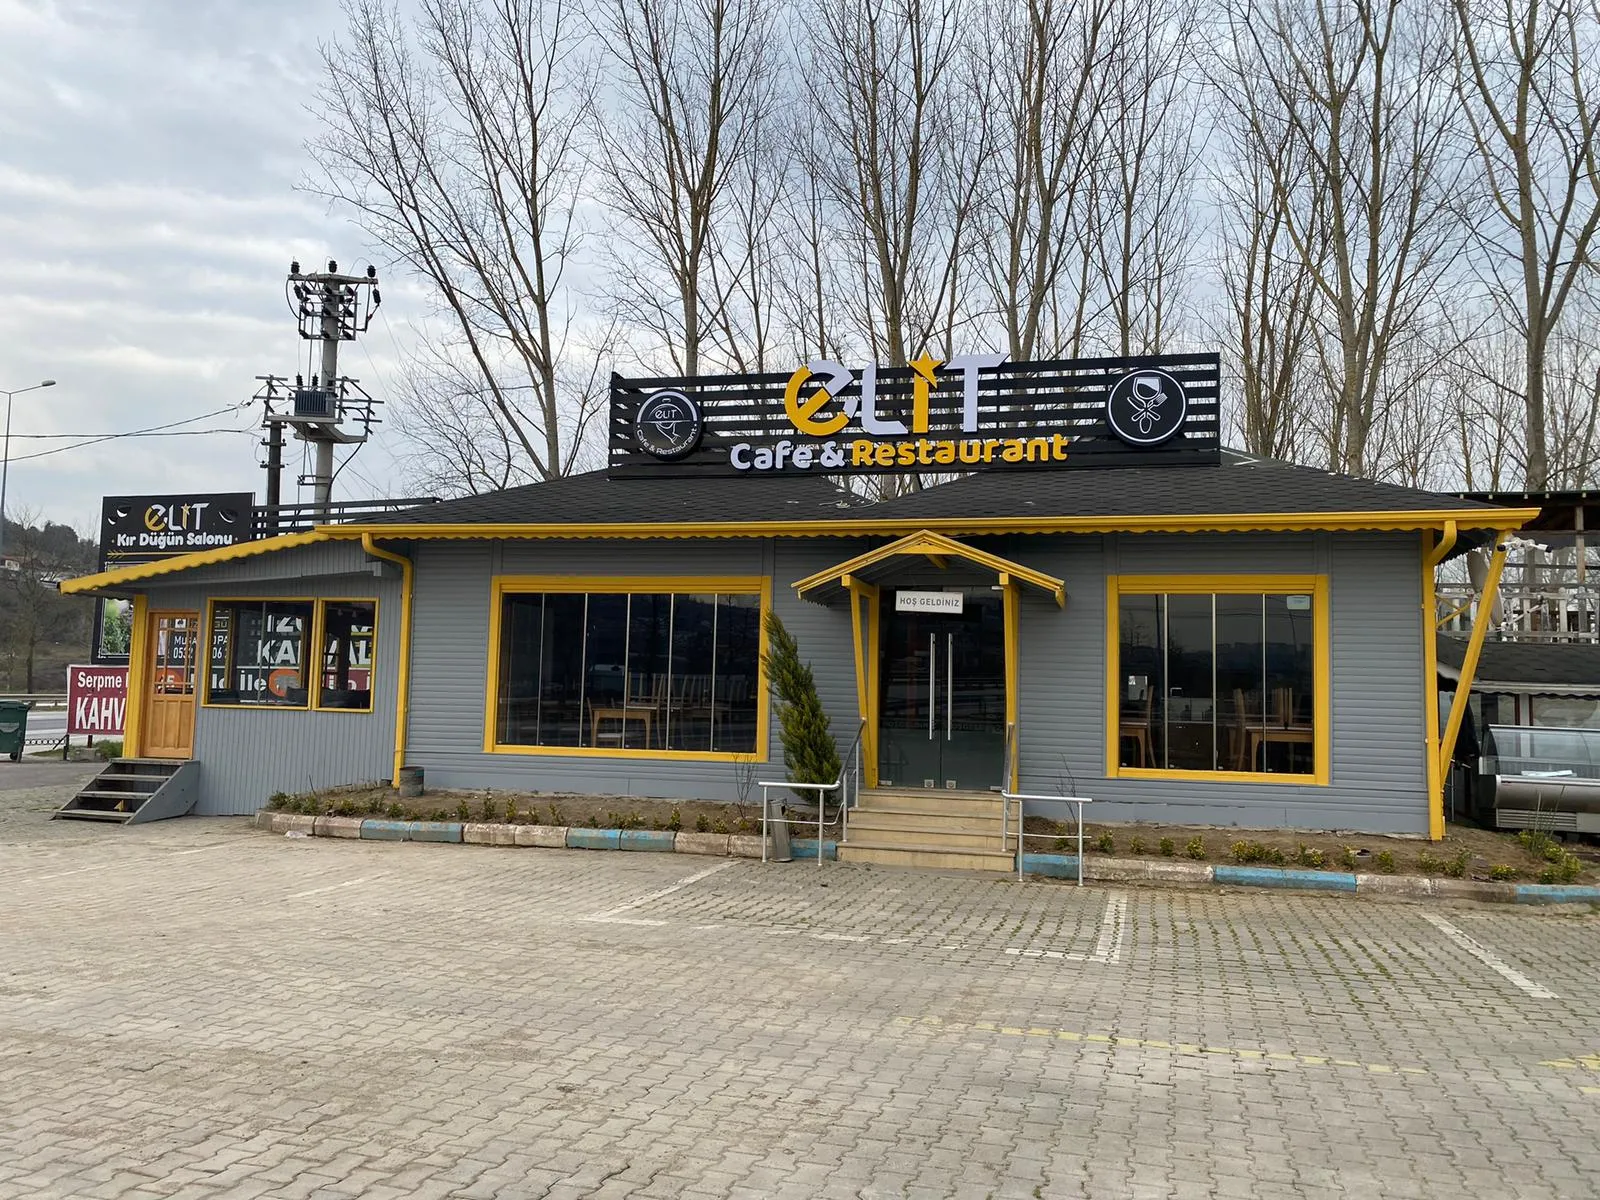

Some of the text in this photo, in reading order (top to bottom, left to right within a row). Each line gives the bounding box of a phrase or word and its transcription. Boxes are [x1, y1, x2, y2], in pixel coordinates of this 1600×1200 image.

[730, 433, 1069, 470] Cafe & Restaurant
[139, 531, 184, 549] Düğün
[186, 532, 233, 546] Salonu
[899, 597, 960, 607] HOŞ GELDİNİZ
[77, 671, 123, 692] Serpme
[75, 696, 126, 731] KAHV
